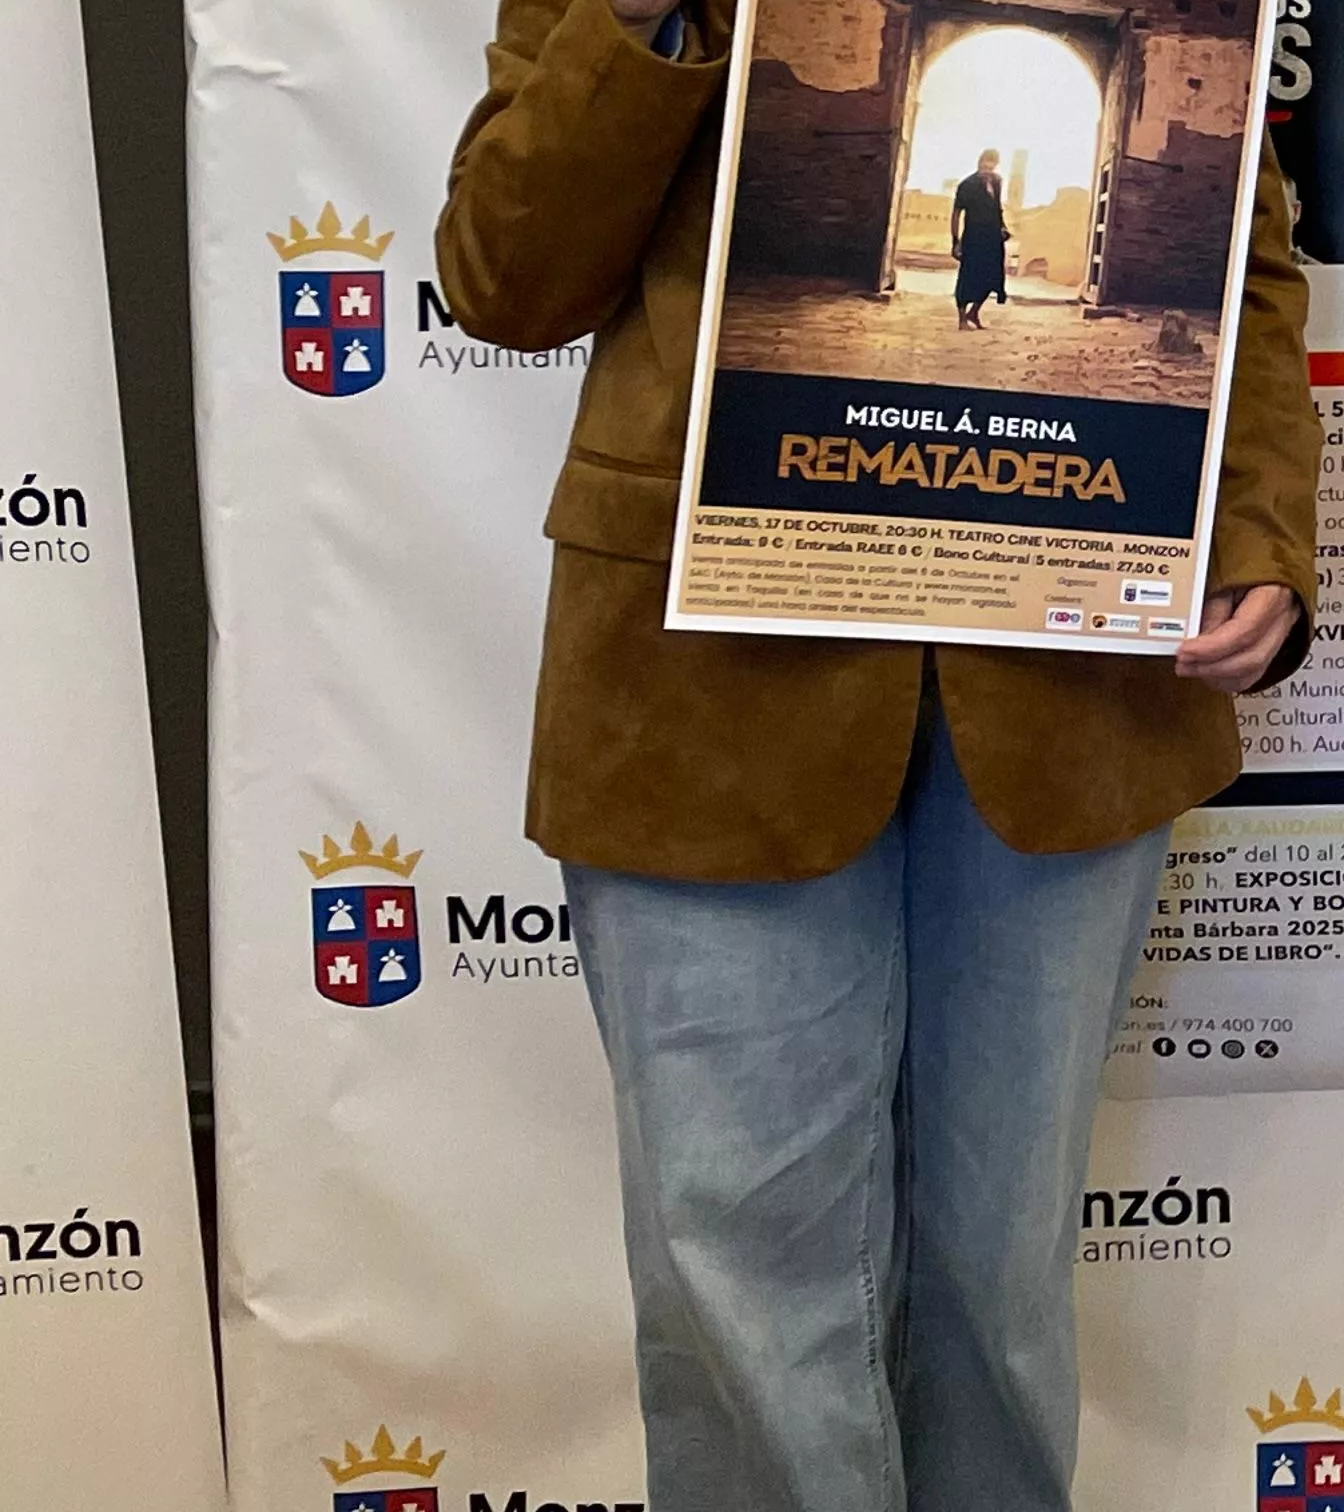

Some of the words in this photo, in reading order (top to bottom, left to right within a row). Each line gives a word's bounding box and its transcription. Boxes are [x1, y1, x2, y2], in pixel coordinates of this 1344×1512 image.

[846, 406, 948, 431] MIGUEL
[954, 408, 979, 434] Á.
[988, 416, 1076, 442] BERNA
[778, 433, 1126, 503] REMATADERA
[1183, 1019, 1215, 1031] 974
[1222, 1019, 1254, 1032] 400
[1263, 1019, 1292, 1032] 700
